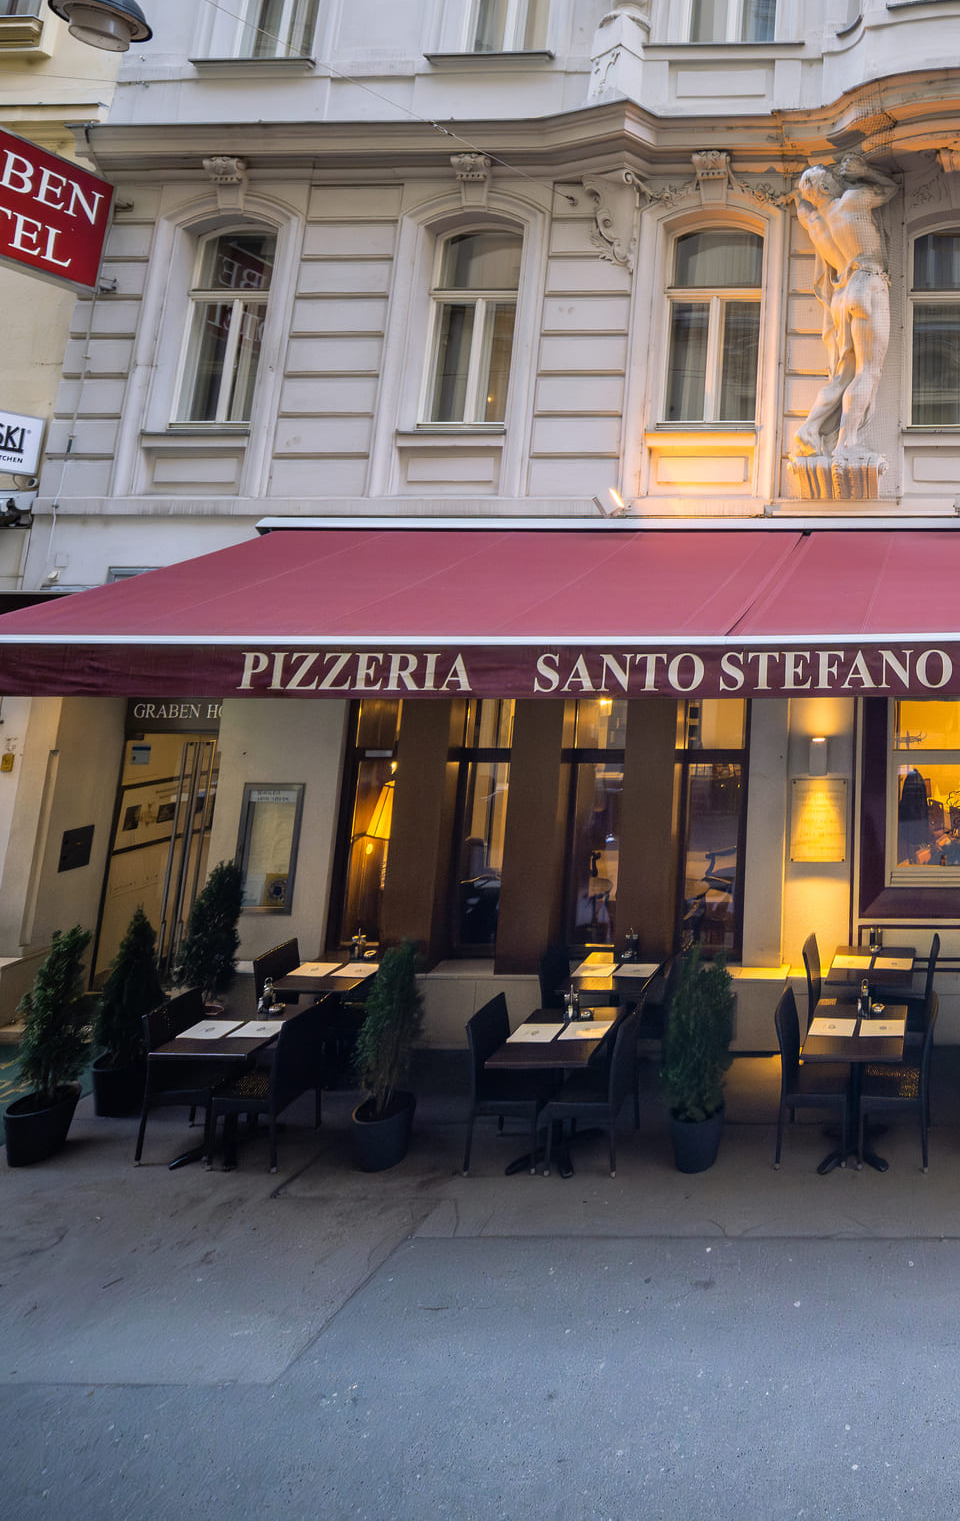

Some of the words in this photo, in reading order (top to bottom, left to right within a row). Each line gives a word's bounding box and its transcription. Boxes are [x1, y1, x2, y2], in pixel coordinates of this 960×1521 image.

[0, 149, 104, 225] BEN
[236, 651, 473, 692] PIZZERIA
[533, 652, 705, 694] SANTO
[719, 649, 953, 692] STEFANO
[133, 703, 202, 719] GRABEN
